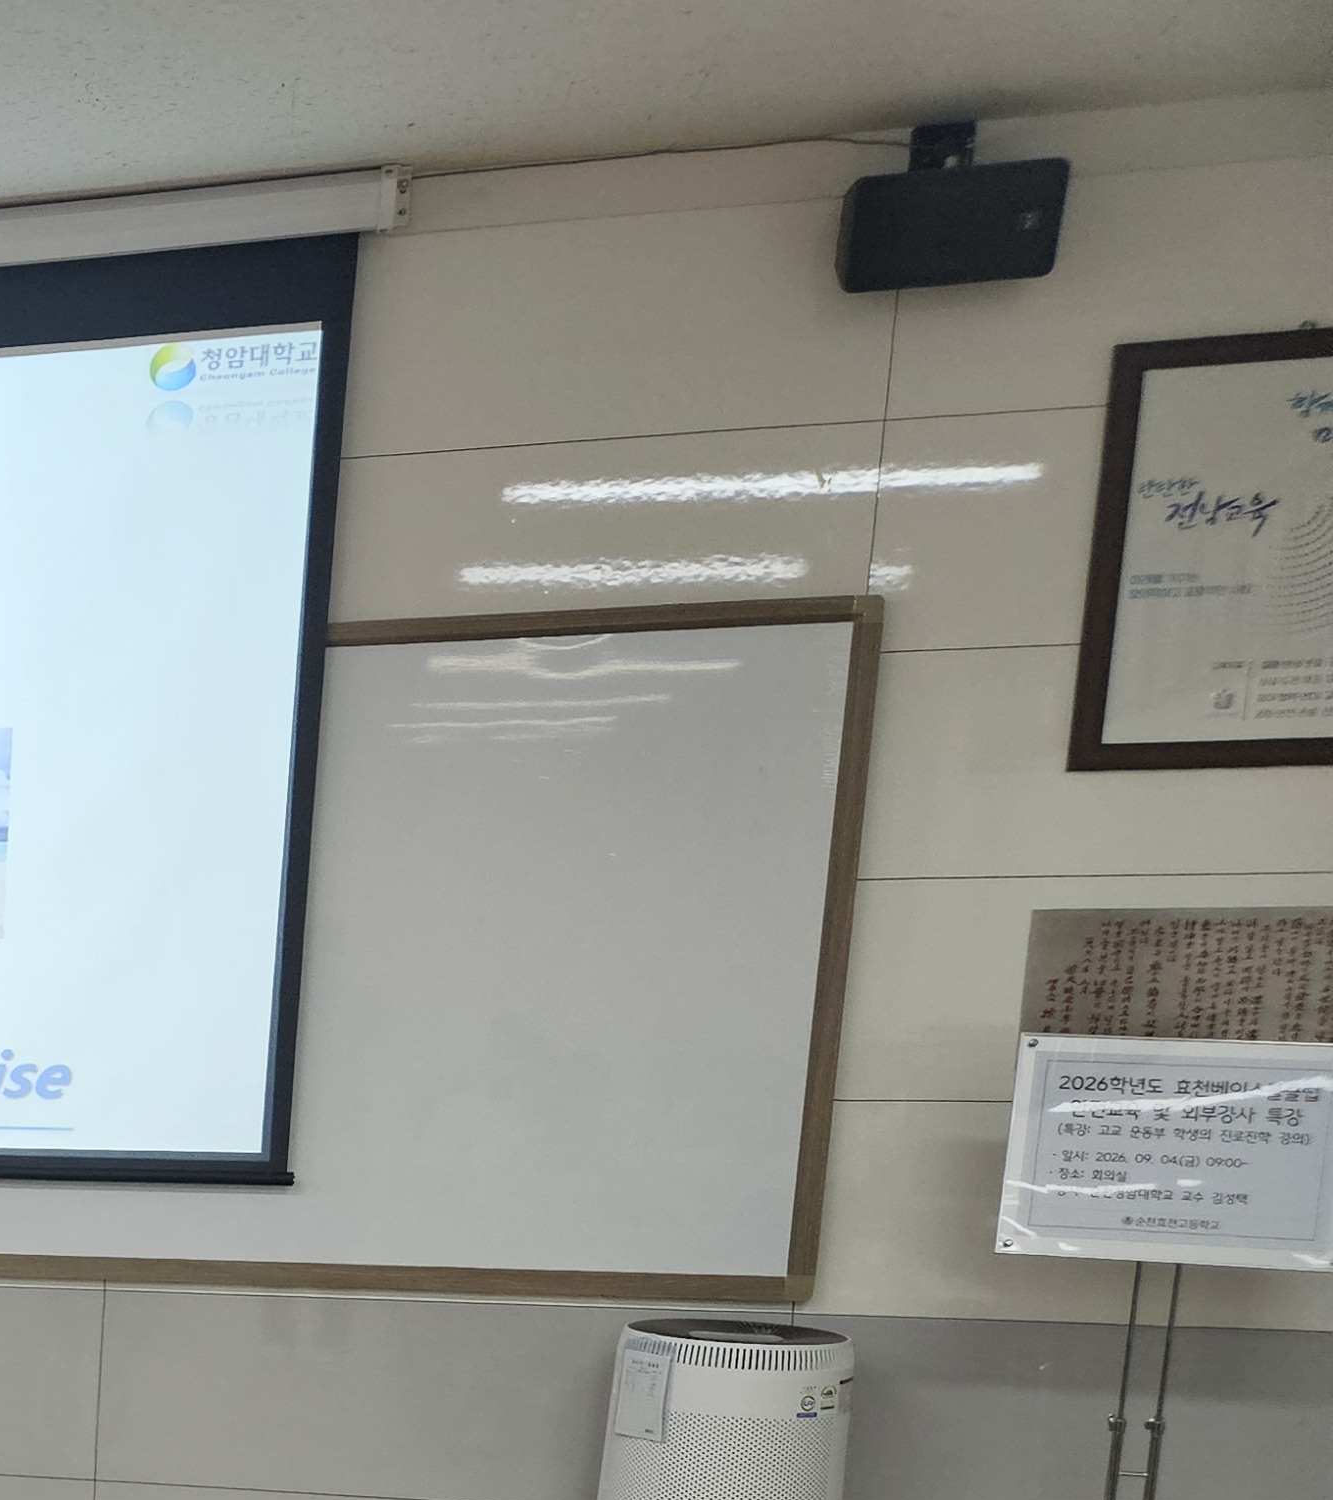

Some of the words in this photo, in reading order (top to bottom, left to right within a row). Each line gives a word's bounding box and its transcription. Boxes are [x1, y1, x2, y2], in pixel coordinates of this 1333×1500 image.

[201, 341, 318, 371] 청암대학교
[199, 370, 265, 382] Cheongam
[269, 366, 317, 377] College
[1165, 490, 1280, 538] 전남교육
[1058, 1075, 1164, 1095] 2026학년도
[1173, 1079, 1320, 1102] 효천베이클럽
[1180, 1105, 1256, 1124] 외부강사
[1265, 1107, 1305, 1127] 특강
[1057, 1122, 1091, 1137] (특강:
[1098, 1125, 1122, 1136] 고교
[1129, 1125, 1166, 1139] 운동부
[1173, 1127, 1212, 1141] 학생의
[1219, 1129, 1271, 1144] 진로진학
[1061, 1149, 1088, 1162] 일시:
[1095, 1152, 1127, 1163] 2026.
[1135, 1153, 1154, 1165] 09.
[1058, 1167, 1084, 1180] 장소:
[1091, 1169, 1127, 1182] 회의실
[1180, 1190, 1204, 1203] 교수
